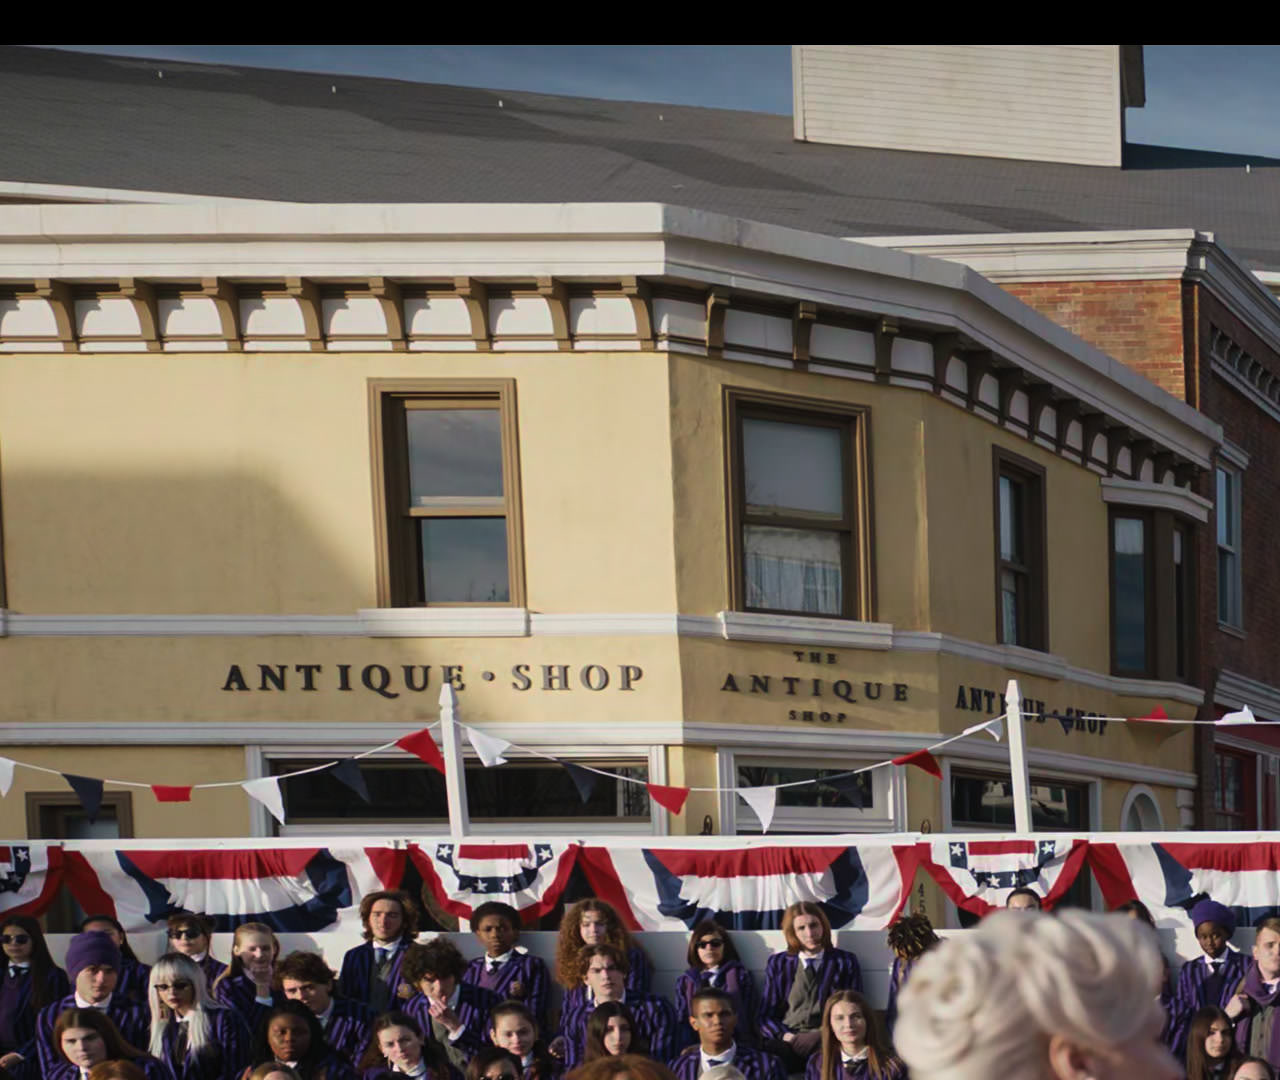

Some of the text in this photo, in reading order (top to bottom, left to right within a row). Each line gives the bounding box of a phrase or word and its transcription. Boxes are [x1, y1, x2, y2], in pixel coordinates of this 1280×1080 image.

[793, 651, 838, 665] THE
[221, 664, 644, 698] ANTIQUE SHOP
[720, 673, 909, 703] ANTIQUE
[789, 710, 848, 723] SHOP
[955, 685, 1046, 723] ANTIUE
